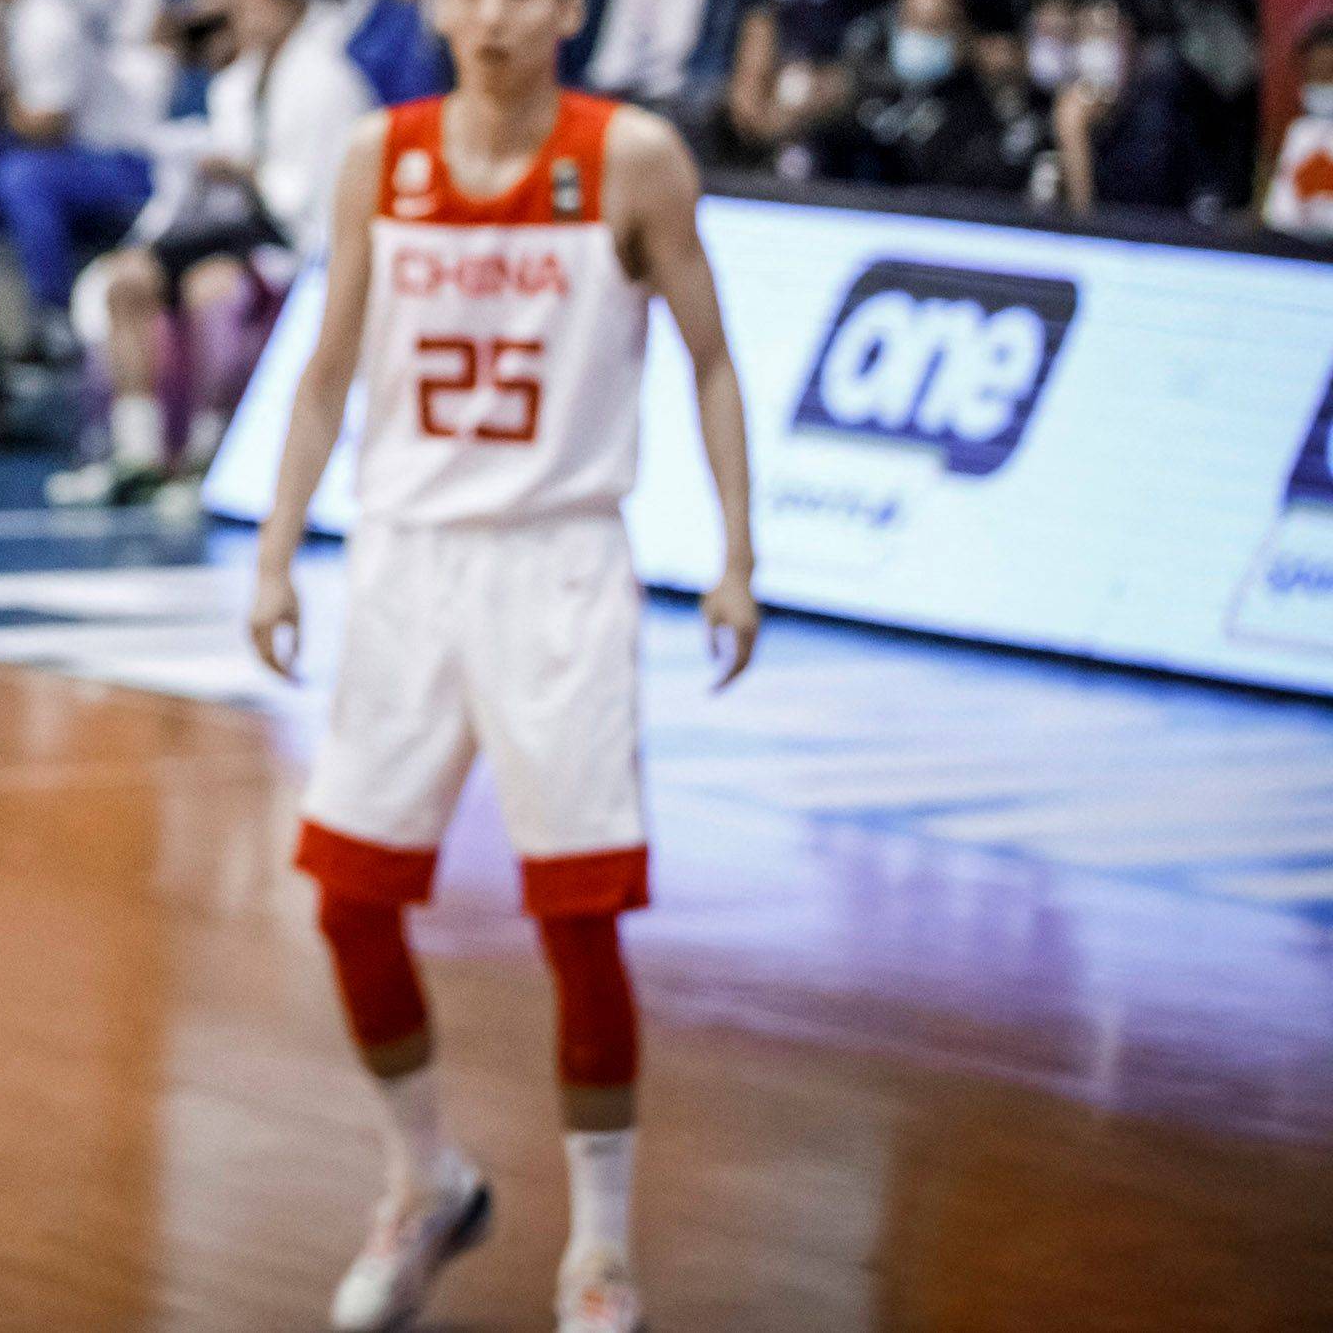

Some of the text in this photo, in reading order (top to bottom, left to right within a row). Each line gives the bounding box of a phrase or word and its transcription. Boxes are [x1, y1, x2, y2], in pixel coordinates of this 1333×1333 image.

[393, 247, 573, 300] CHINA
[416, 334, 544, 443] 25
[820, 288, 1046, 444] one
